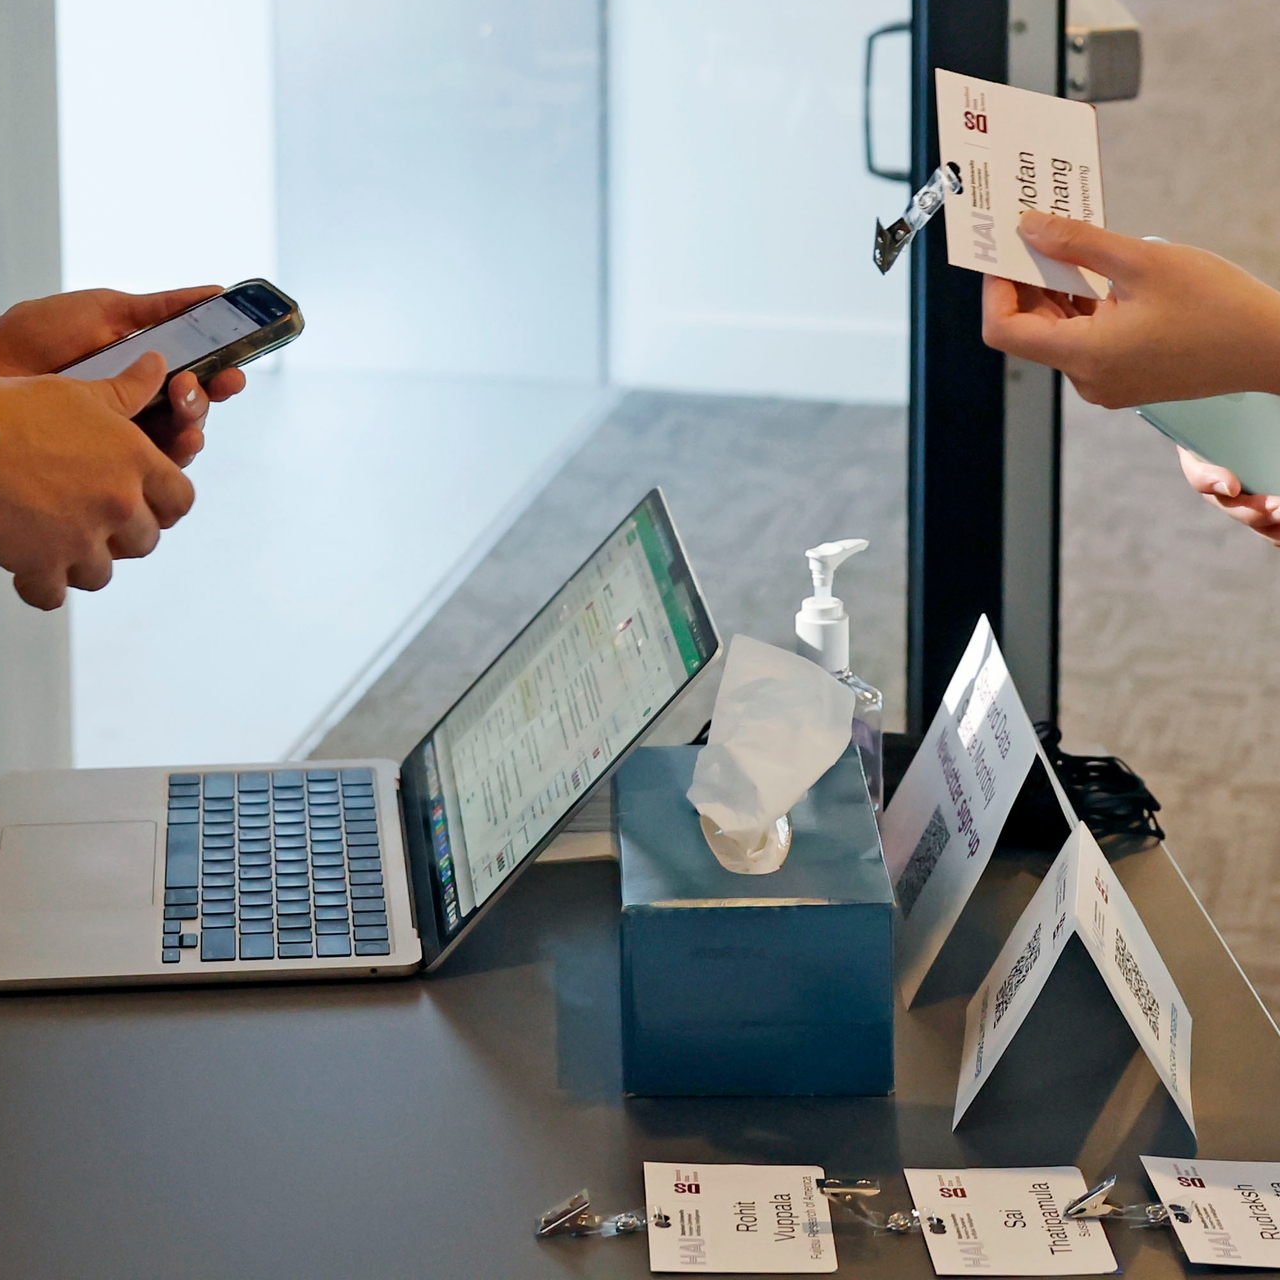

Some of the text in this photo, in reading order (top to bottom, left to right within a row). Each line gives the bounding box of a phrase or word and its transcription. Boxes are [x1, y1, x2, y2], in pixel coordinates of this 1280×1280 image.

[1049, 158, 1072, 220] hang
[1079, 165, 1093, 222] ngineering
[994, 713, 1012, 761] Data
[936, 726, 981, 858] Newsletter sign-up
[972, 741, 997, 811] Monthly
[803, 1175, 814, 1201] America
[733, 1201, 758, 1233] Rohit
[769, 1193, 800, 1242] Vuppala
[804, 1209, 820, 1237] Research
[999, 1209, 1026, 1229] Sai
[1029, 1181, 1072, 1255] Thatipamula
